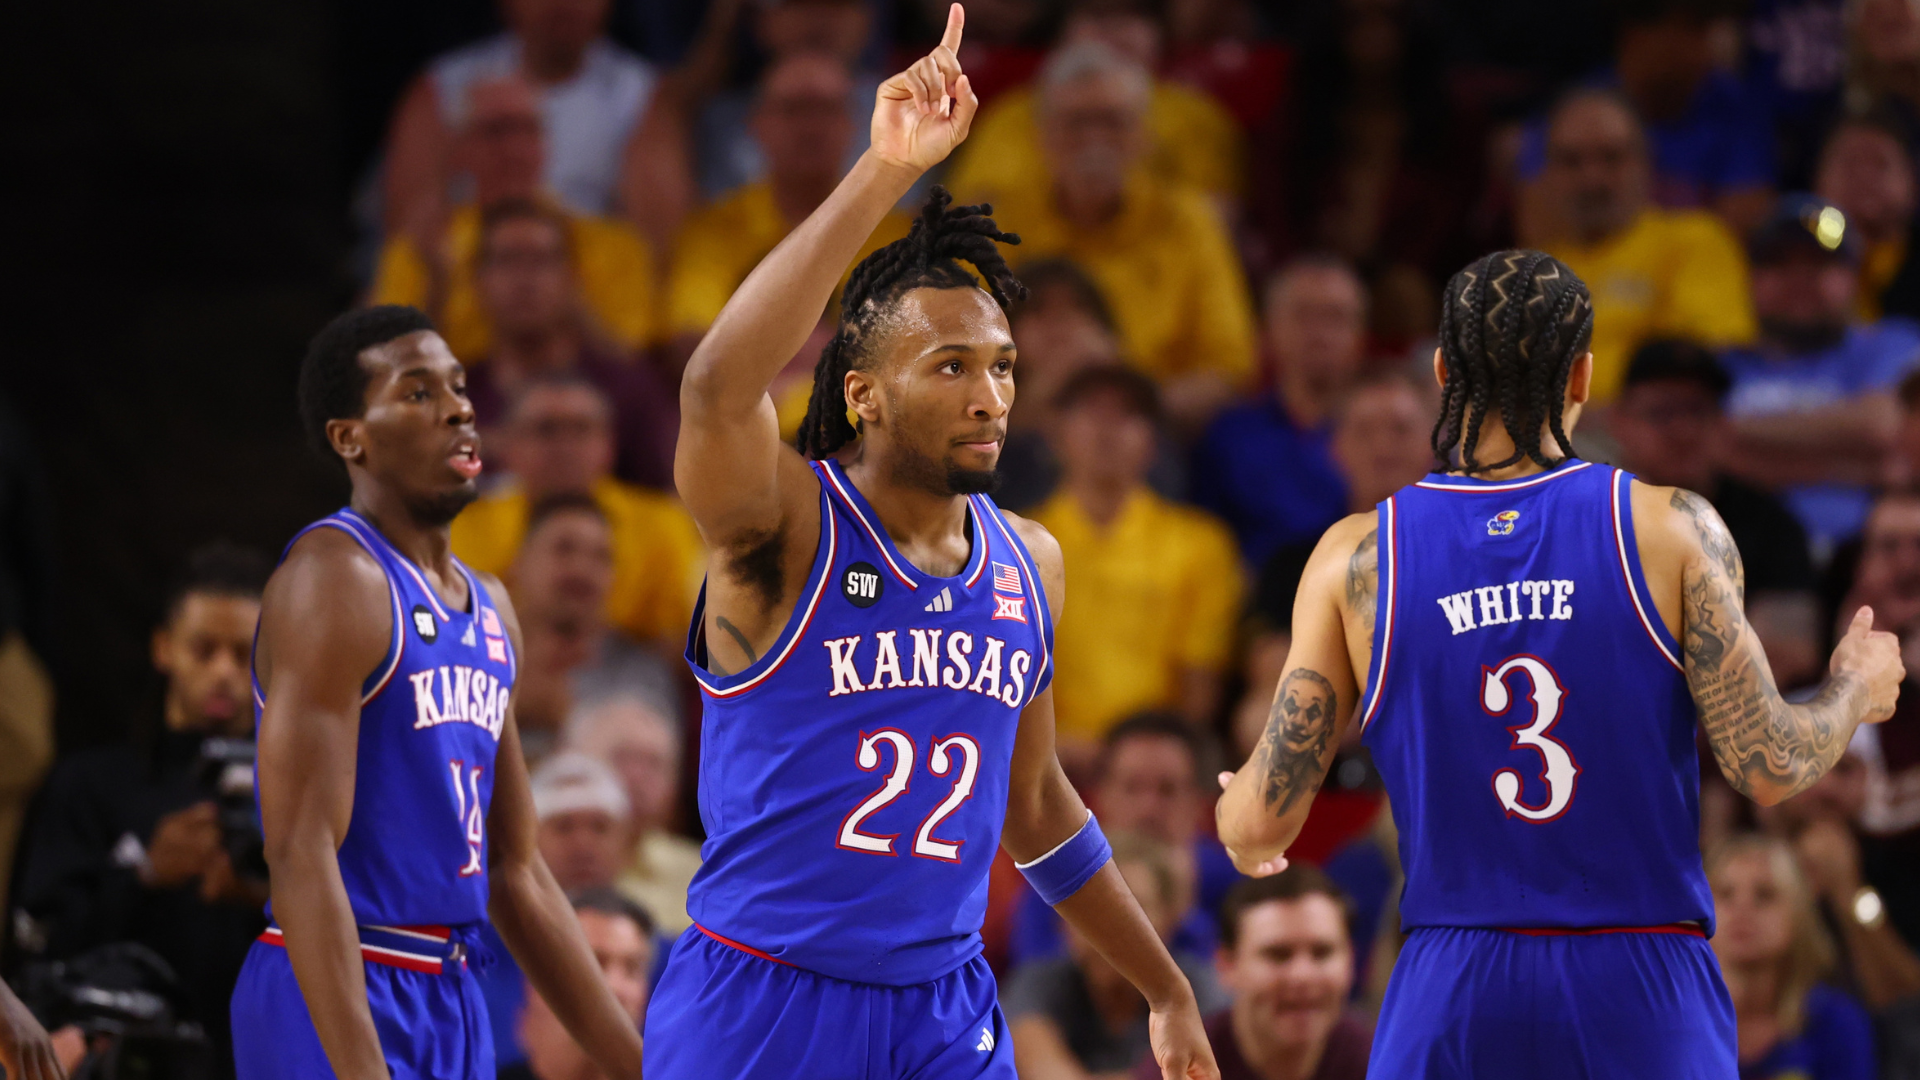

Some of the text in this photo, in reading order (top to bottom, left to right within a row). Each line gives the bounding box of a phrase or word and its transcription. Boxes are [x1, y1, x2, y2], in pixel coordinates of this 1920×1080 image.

[847, 571, 878, 598] SW
[994, 598, 1027, 622] XII
[1436, 579, 1575, 636] WHITE
[409, 664, 510, 742] KANSAS
[823, 628, 1031, 708] KANSAS
[1479, 653, 1584, 825] 3
[449, 758, 484, 877] 14
[835, 726, 982, 864] 22
